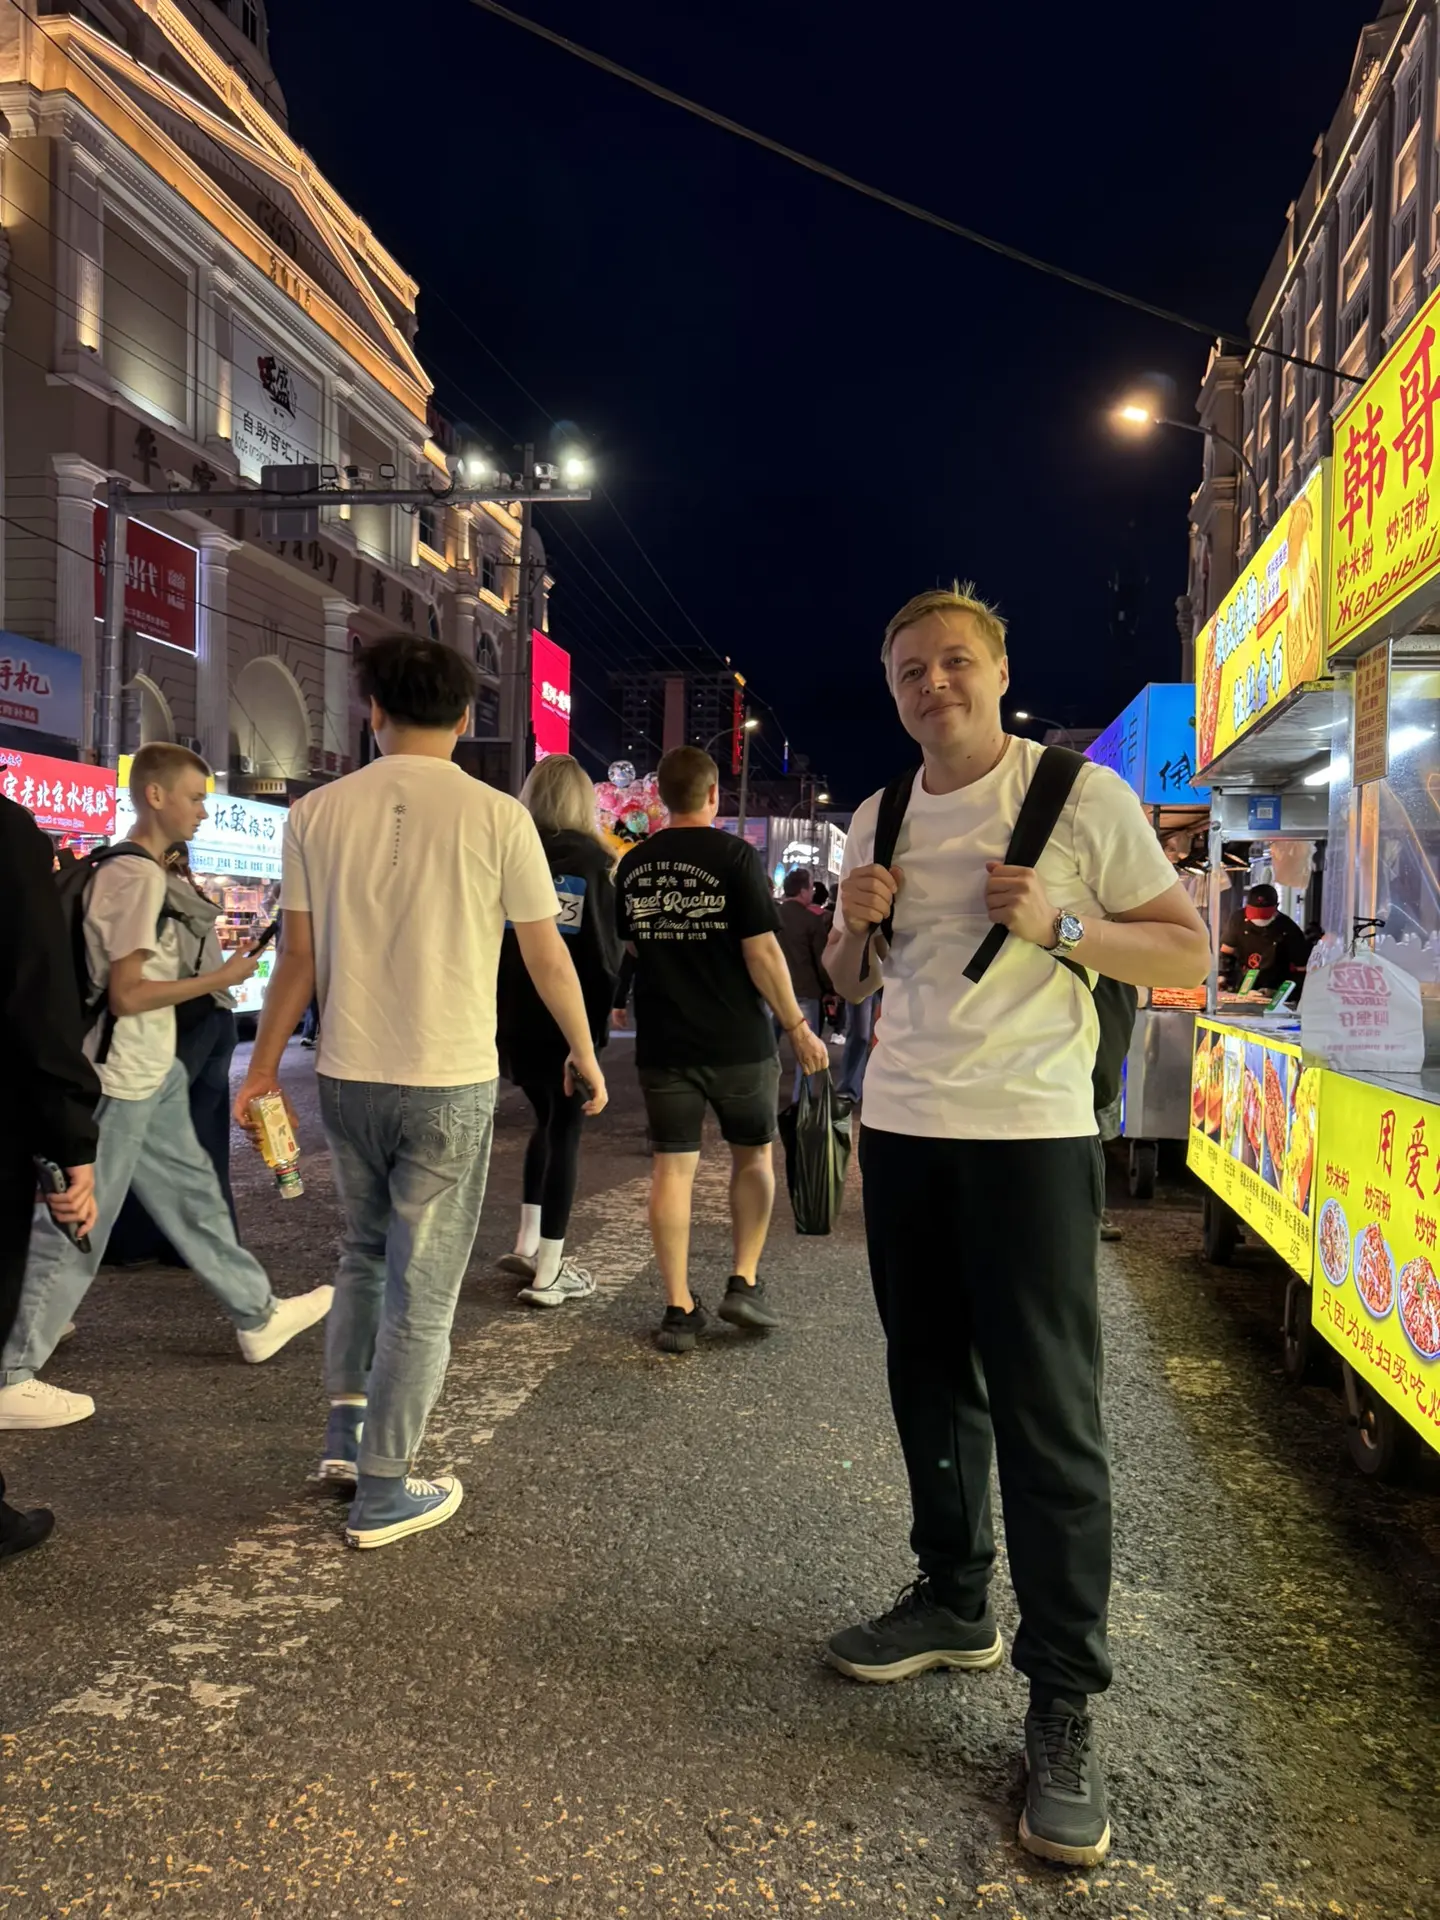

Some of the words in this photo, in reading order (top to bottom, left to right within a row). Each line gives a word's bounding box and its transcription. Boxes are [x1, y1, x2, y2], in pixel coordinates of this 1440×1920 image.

[243, 411, 293, 463] 自助百汇
[1337, 325, 1440, 547] 韩哥
[1336, 533, 1374, 596] 炒米粉
[1385, 483, 1430, 556] 炒河粉
[1335, 520, 1438, 632] Жареный
[656, 861, 670, 870] THE
[673, 862, 720, 888] COMPETITION
[663, 891, 726, 918] Racing
[1325, 1159, 1350, 1197] 炒米粉
[1364, 1181, 1391, 1222] 炒河粉
[1414, 1208, 1438, 1252] 炒饼
